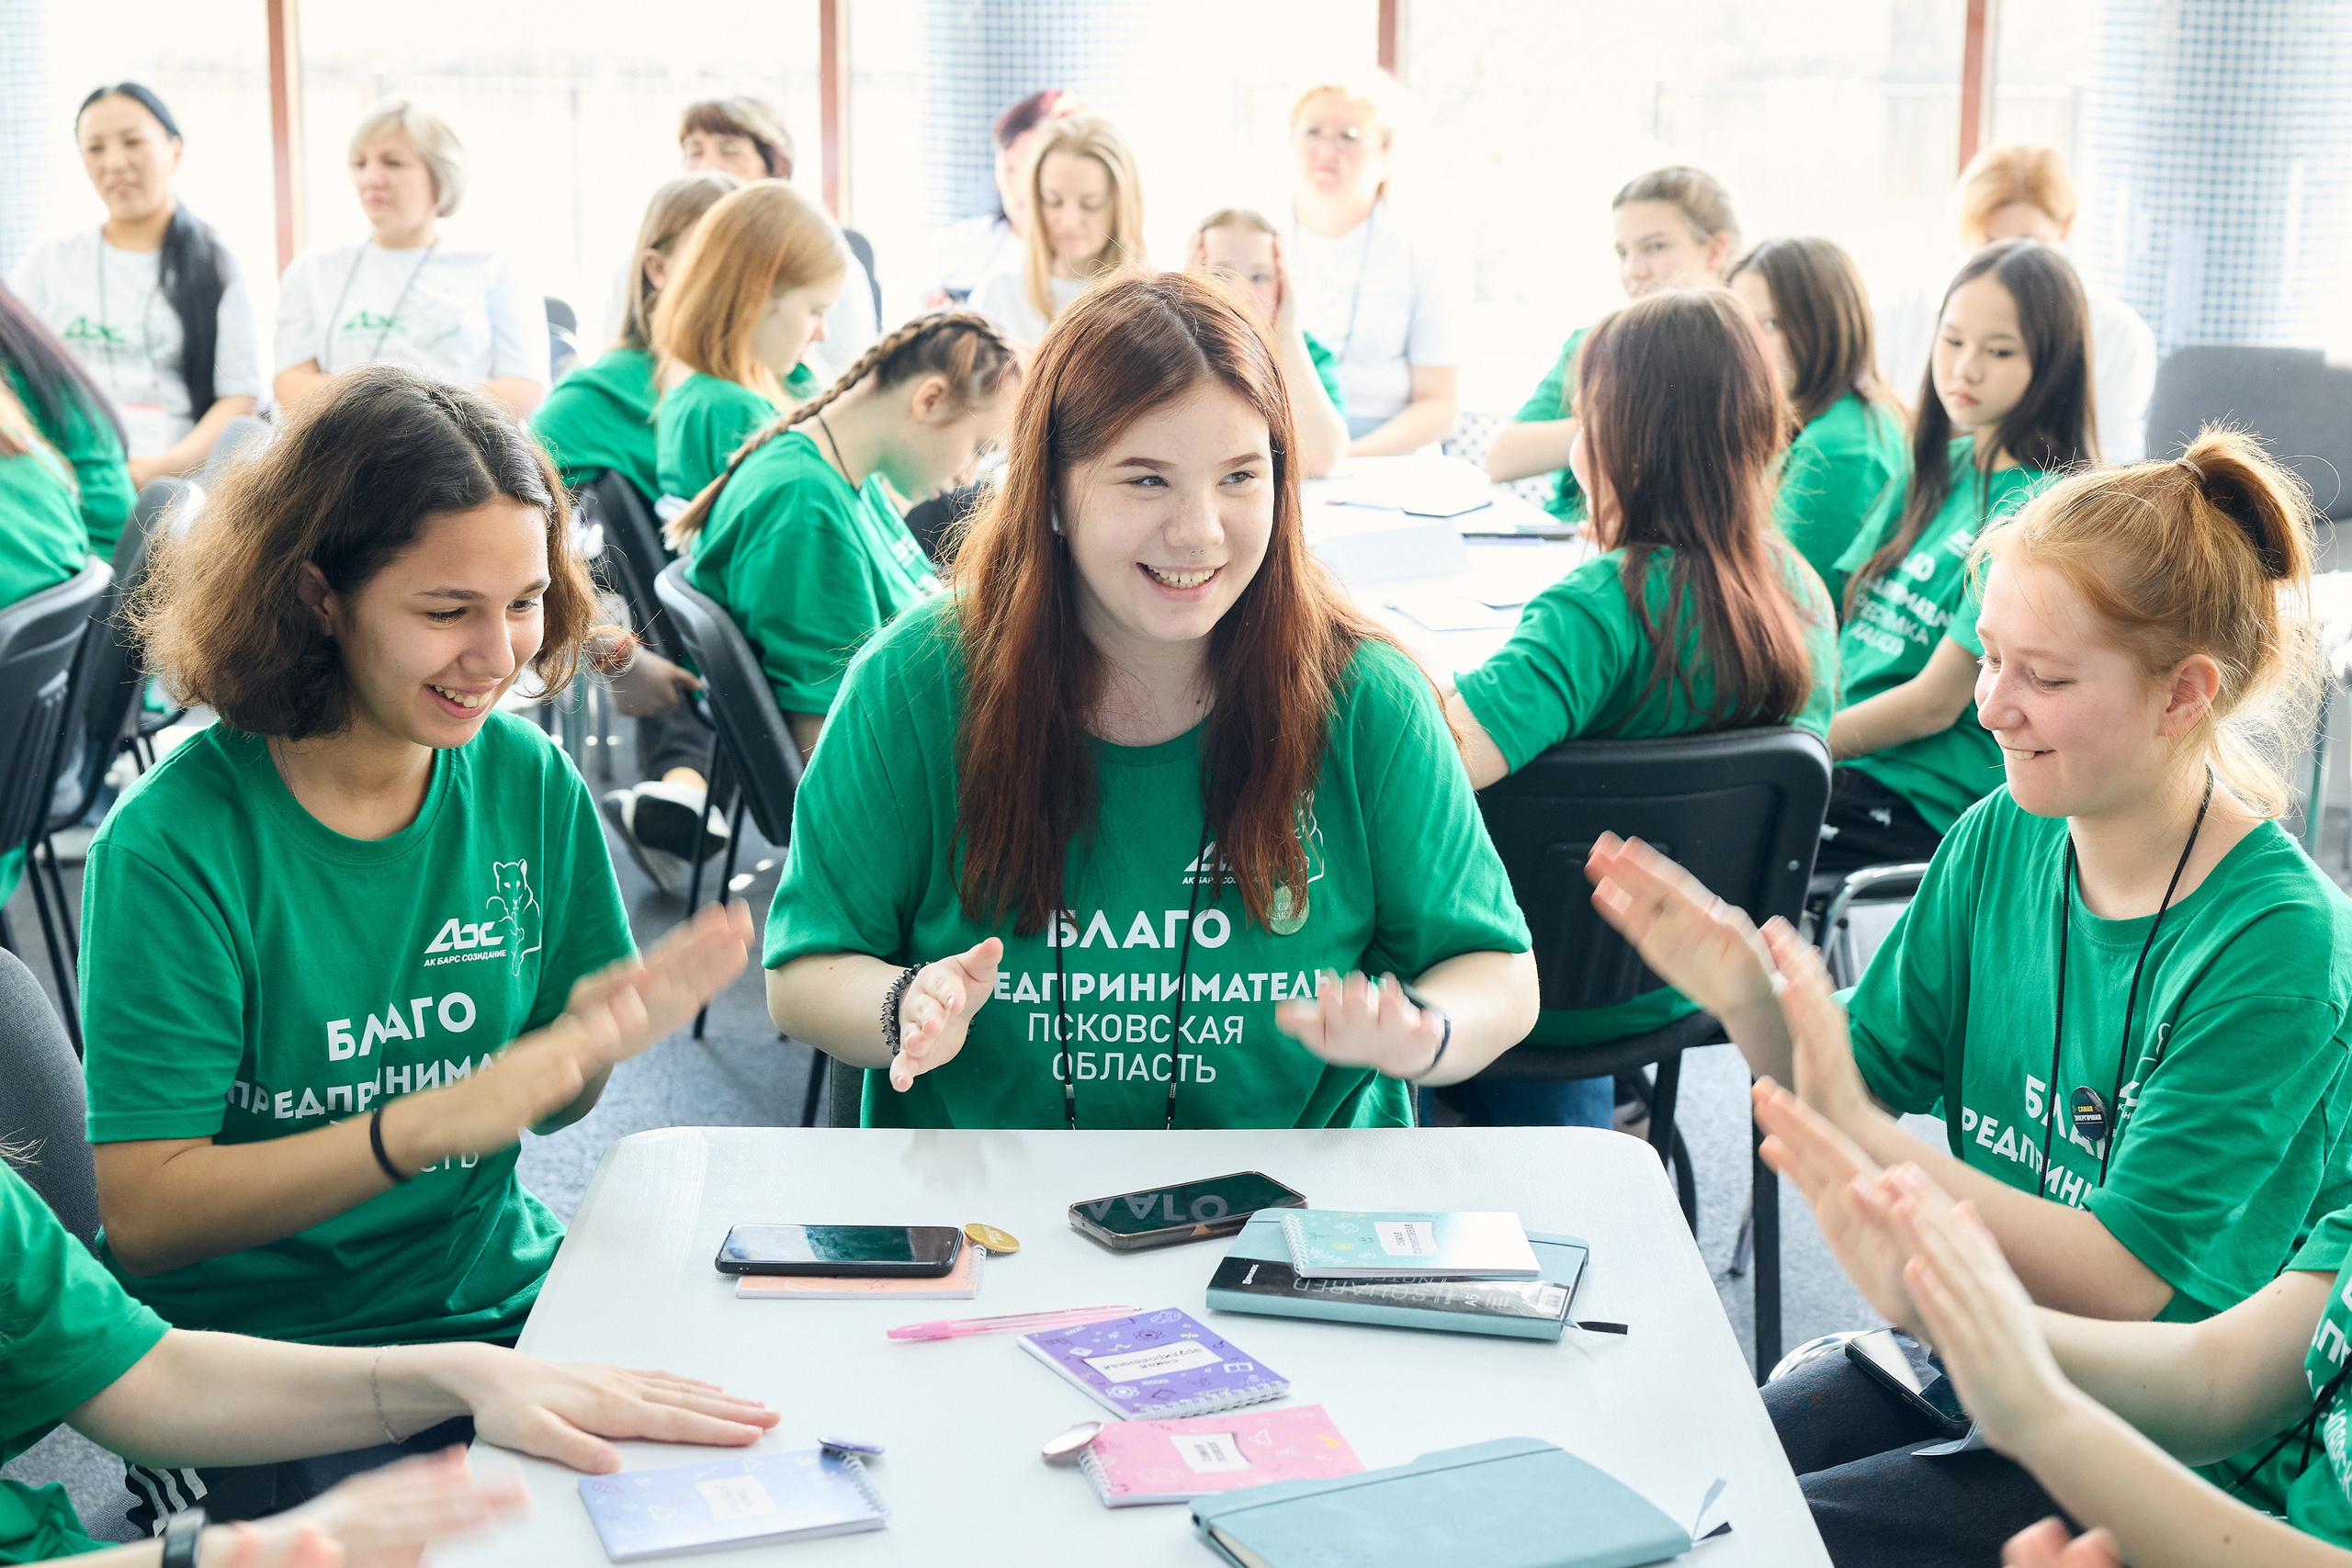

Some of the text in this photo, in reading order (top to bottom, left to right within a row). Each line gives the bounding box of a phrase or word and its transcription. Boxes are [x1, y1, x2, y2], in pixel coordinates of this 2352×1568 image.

[1046, 908, 1231, 949] БЛАГО
[424, 949, 507, 967] АК БАРС СОЗИДАНИЕ
[993, 968, 1329, 1004] ЕДПРИНИМАТЕЛЬ
[326, 992, 477, 1062] БЛАГО
[1028, 1012, 1245, 1044] ПСКОВСКАЯ
[1052, 1052, 1217, 1084] ОБЛАСТЬ
